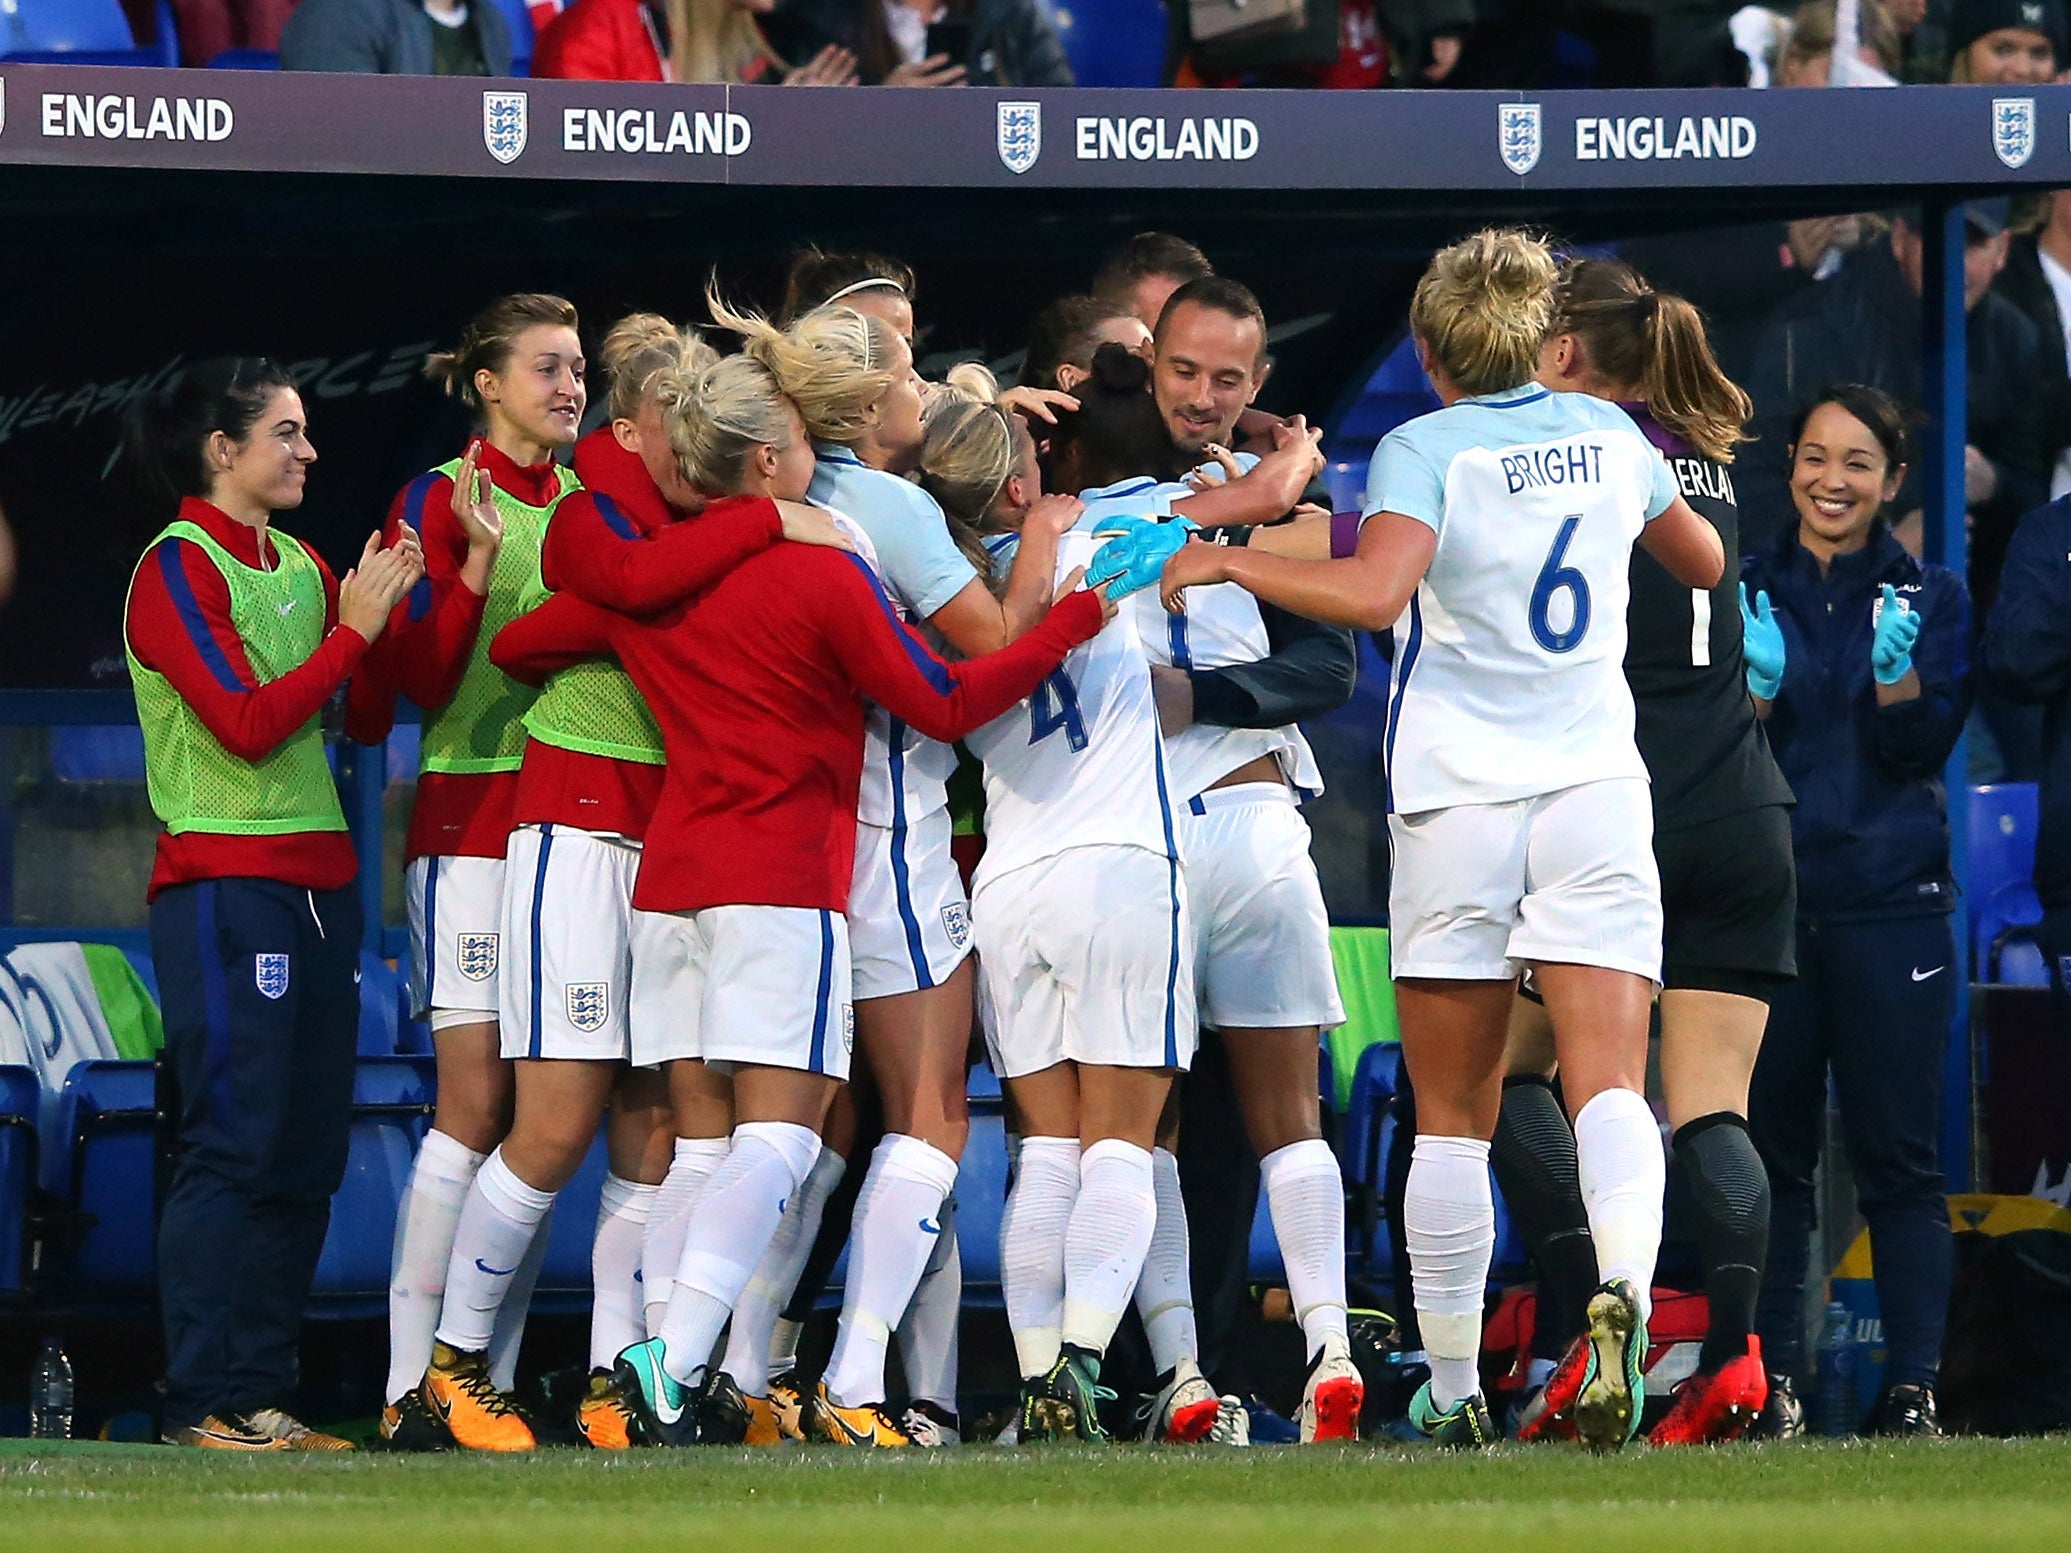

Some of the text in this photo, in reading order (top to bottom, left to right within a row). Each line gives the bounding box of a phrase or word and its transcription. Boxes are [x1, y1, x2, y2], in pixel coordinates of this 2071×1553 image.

[41, 92, 235, 142] ENGLAND
[563, 108, 752, 156] ENGLAND
[1075, 116, 1260, 161] ENGLAND
[1575, 115, 1758, 161] ENGLAND
[1501, 445, 1605, 496] BRIGHT
[1528, 513, 1591, 655] 6
[1691, 587, 1712, 667] 1
[1028, 660, 1089, 754] 4
